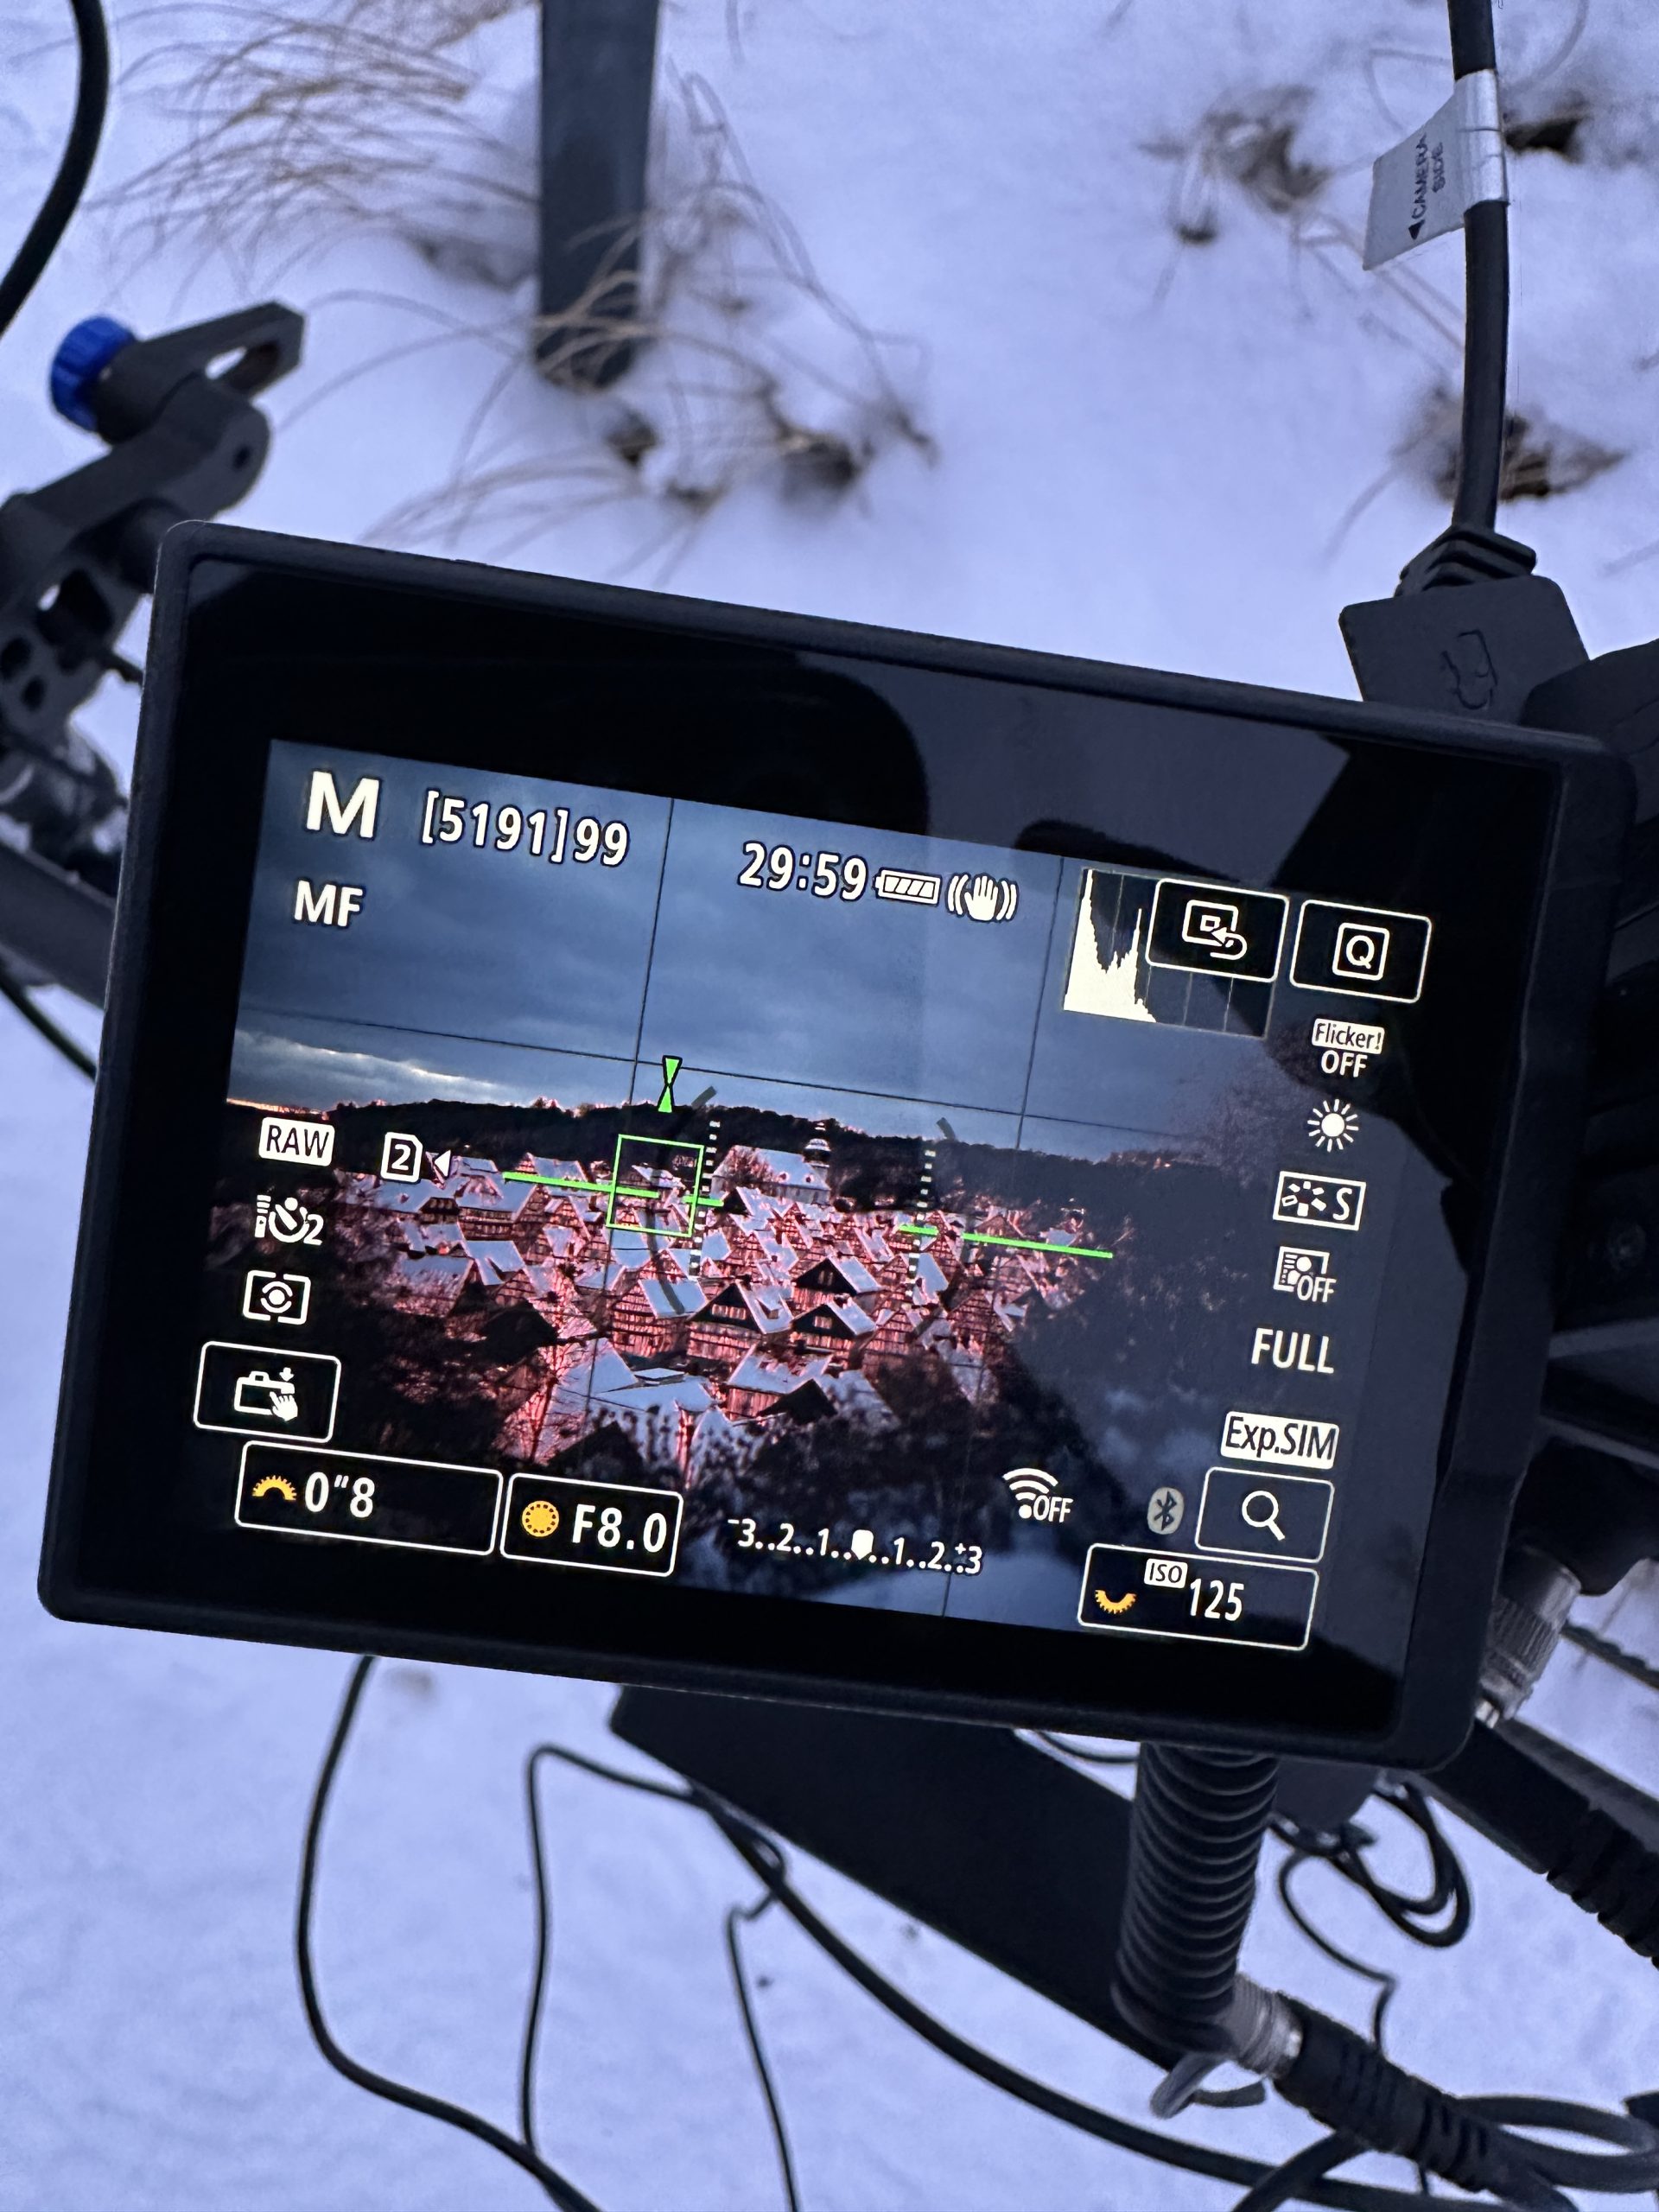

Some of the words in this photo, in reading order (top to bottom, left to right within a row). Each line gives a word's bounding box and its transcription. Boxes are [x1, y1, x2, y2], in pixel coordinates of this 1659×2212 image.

[306, 771, 379, 838] M
[740, 839, 868, 900] 29:59
[294, 880, 363, 927] MF
[1344, 933, 1375, 969] Q
[1315, 1022, 1382, 1051] Flicker!
[1321, 1050, 1368, 1077] OFF
[265, 1124, 330, 1159] RAW
[391, 1143, 410, 1171] 2
[1331, 1186, 1354, 1221] S
[1297, 1274, 1337, 1303] OFF
[1251, 1327, 1335, 1374] FULL
[1225, 1415, 1337, 1460] Exp.SIM
[1033, 1495, 1073, 1523] OFF
[572, 1503, 667, 1553] F8.0
[1148, 1562, 1183, 1584] ISO
[1190, 1578, 1244, 1621] 125
